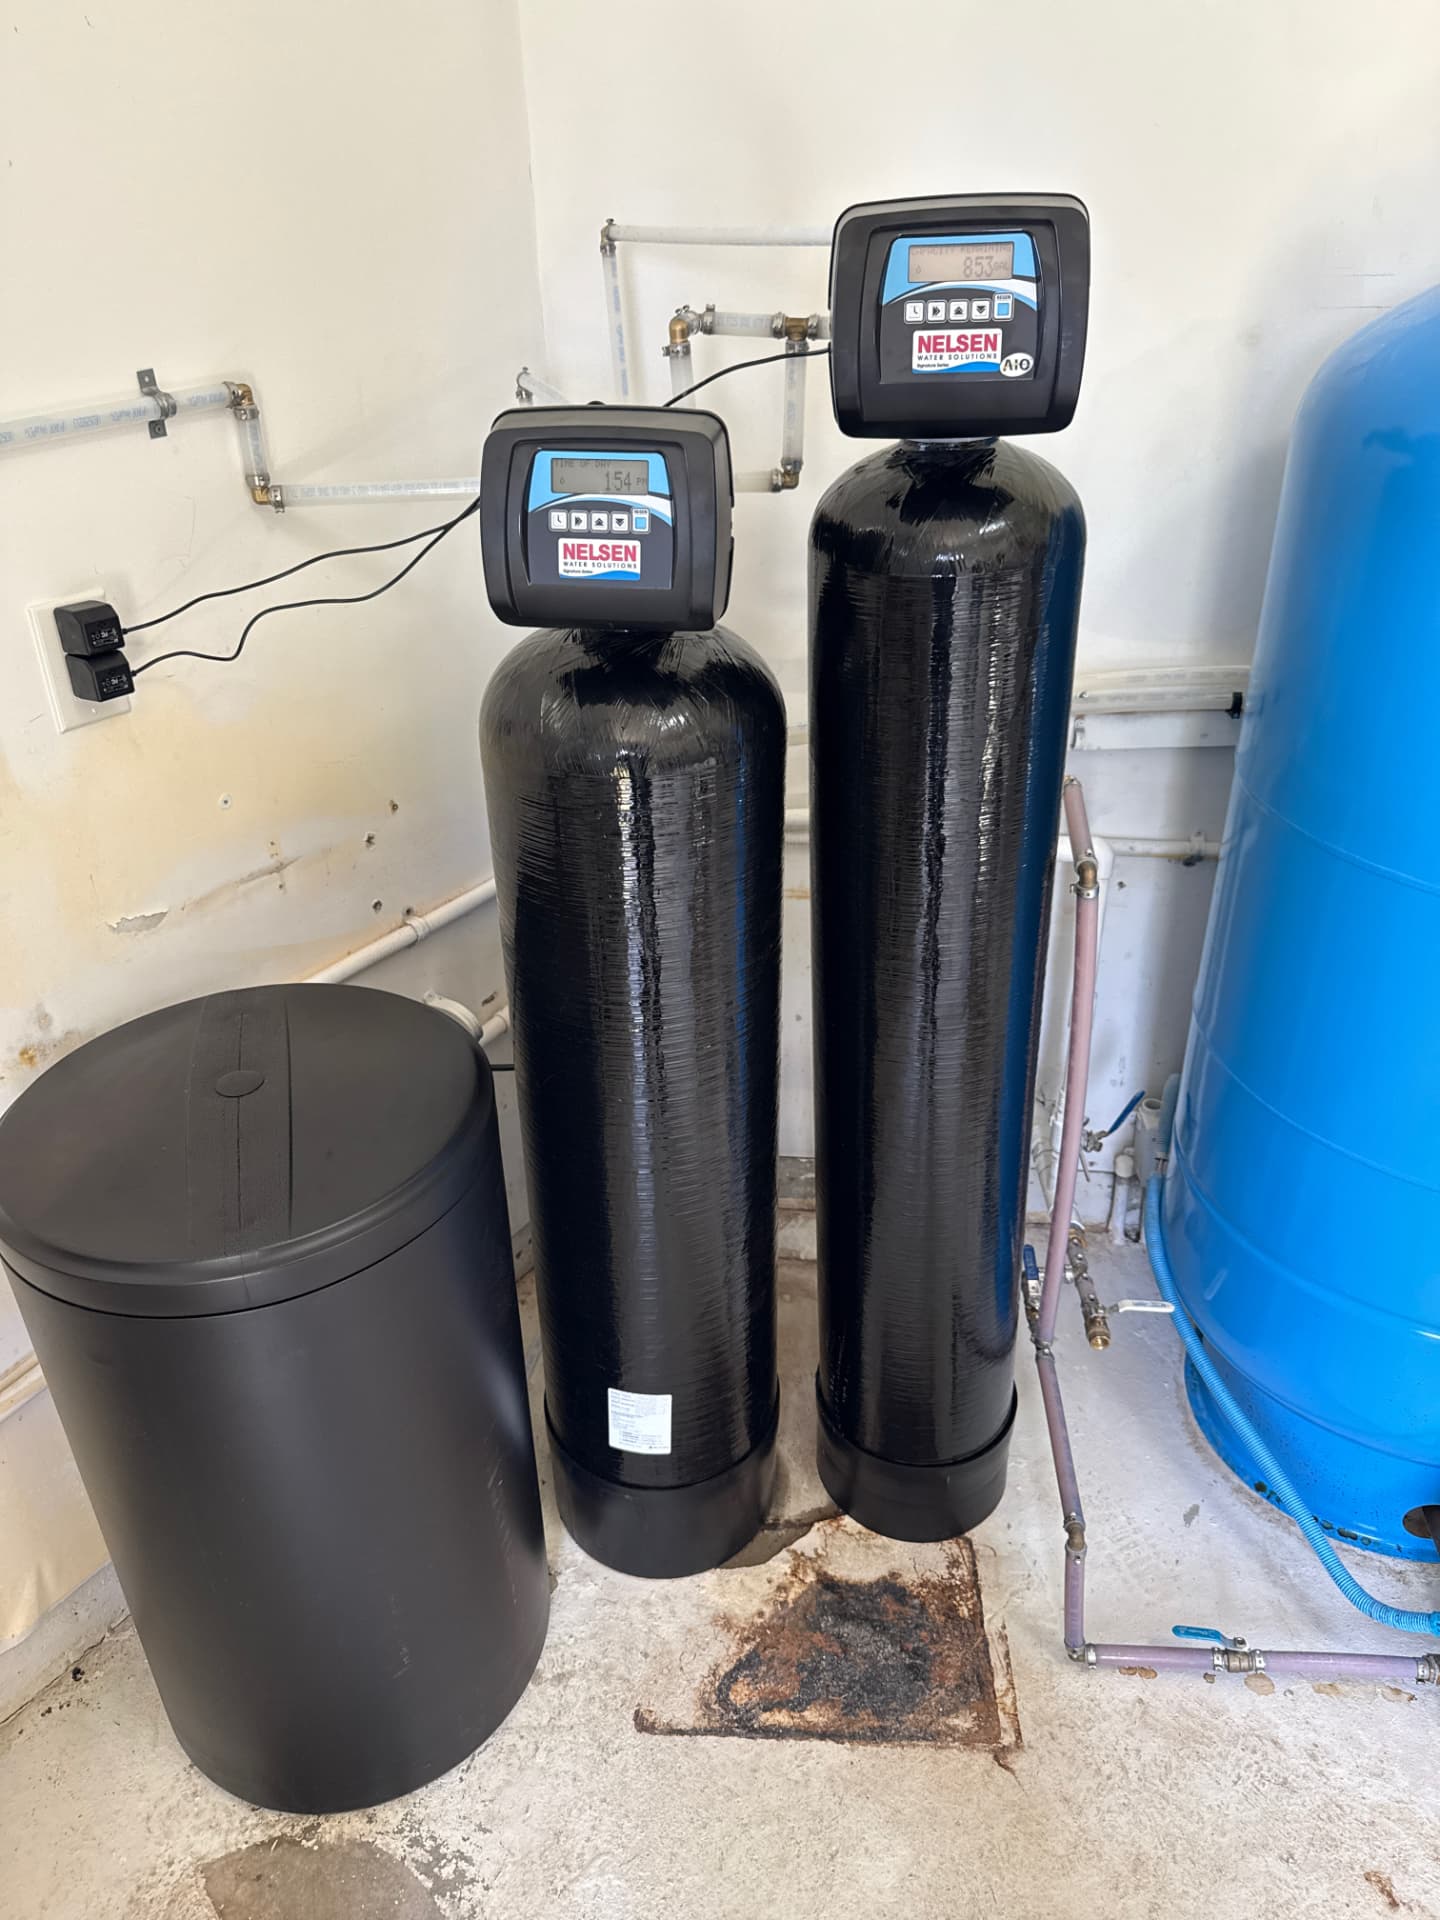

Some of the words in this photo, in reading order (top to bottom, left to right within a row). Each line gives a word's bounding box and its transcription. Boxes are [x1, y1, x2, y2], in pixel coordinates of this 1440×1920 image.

[963, 256, 994, 278] 853
[918, 333, 998, 353] NELSEN
[563, 543, 637, 562] NELSEN
